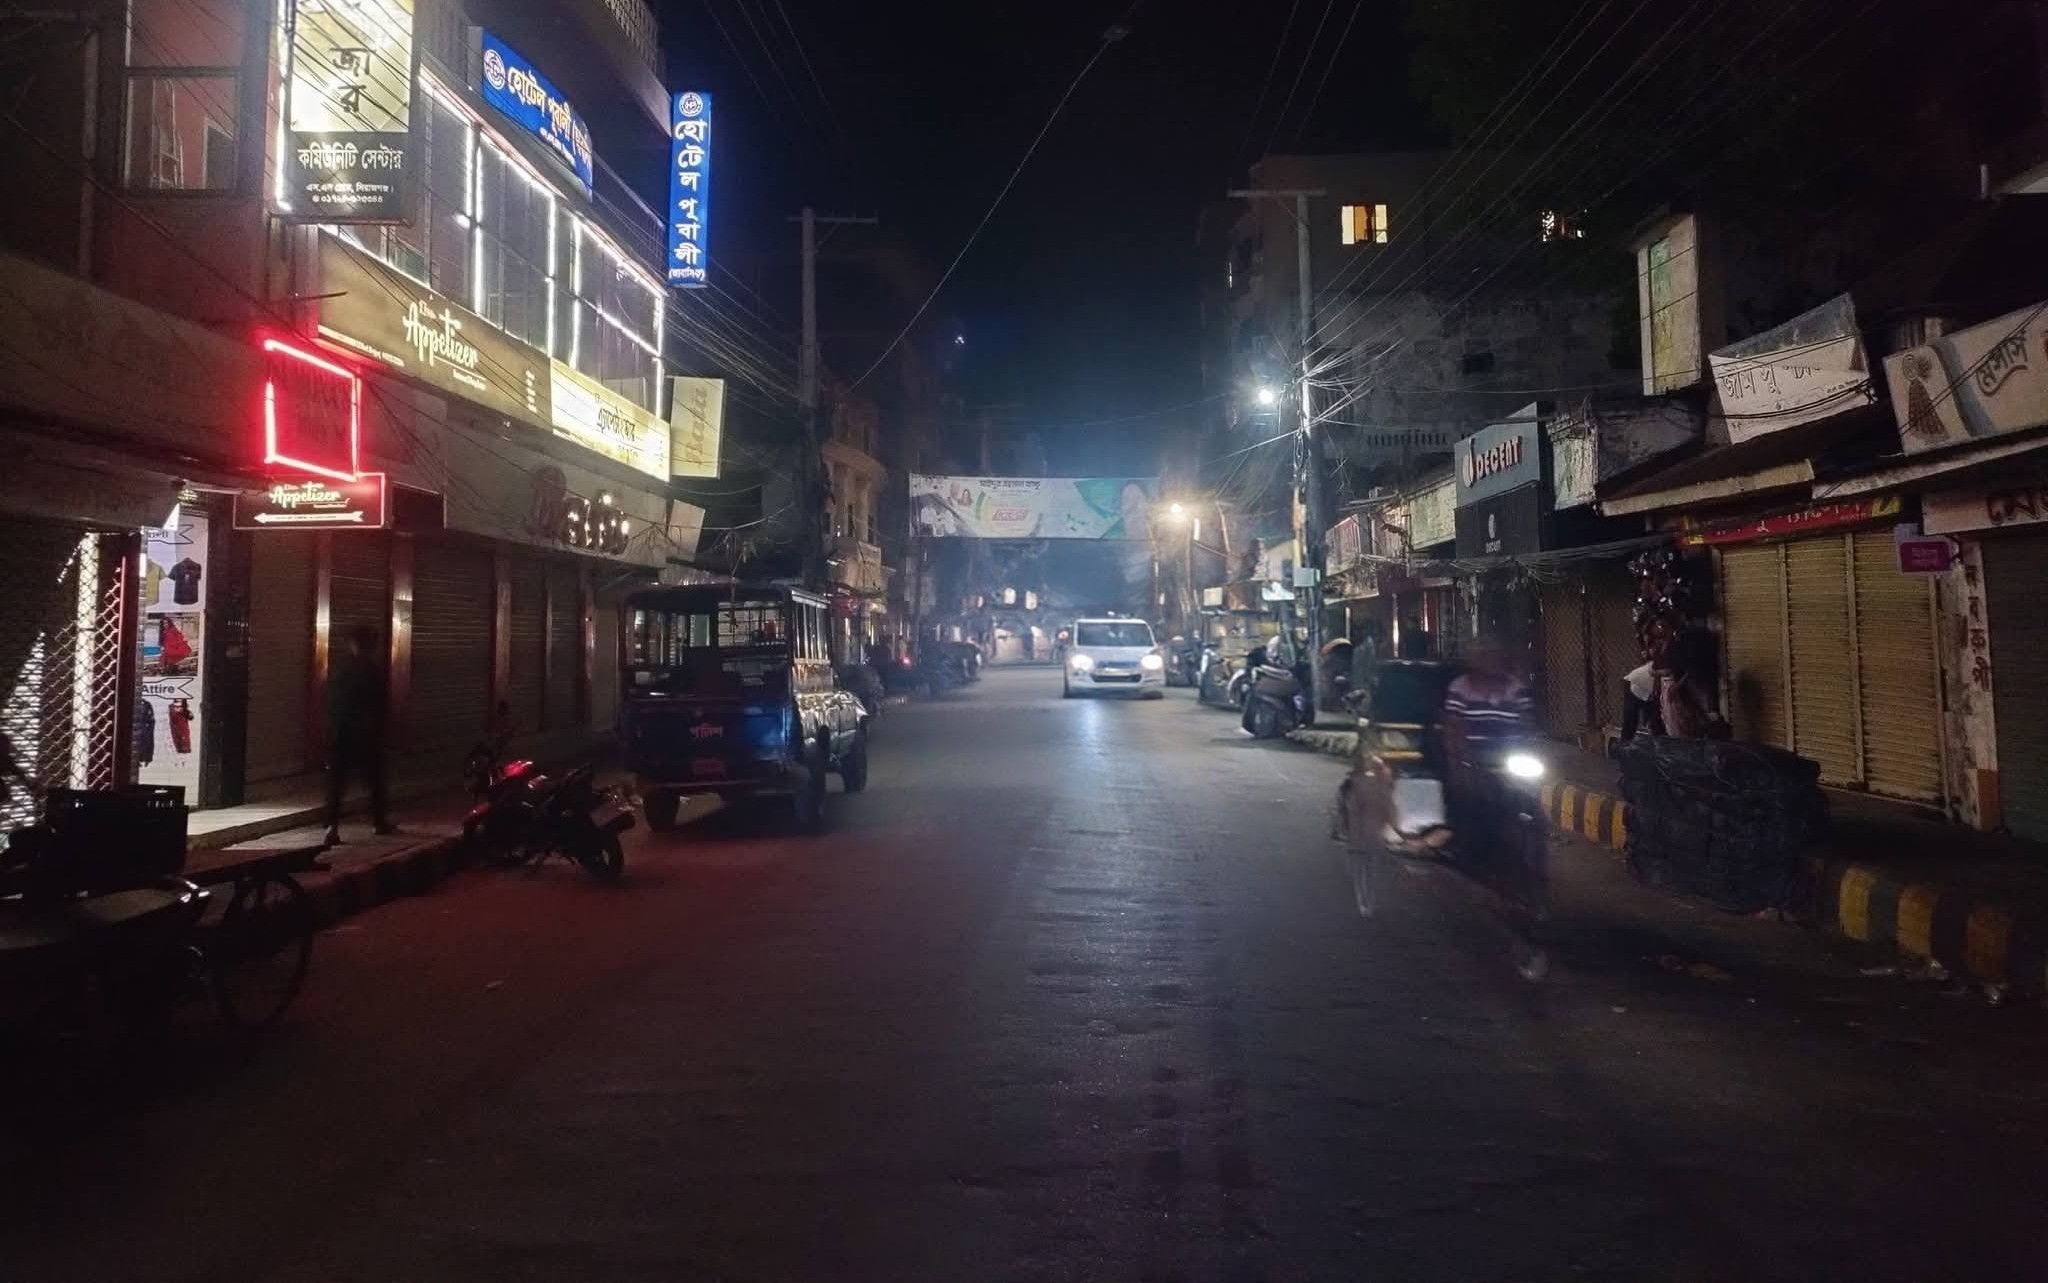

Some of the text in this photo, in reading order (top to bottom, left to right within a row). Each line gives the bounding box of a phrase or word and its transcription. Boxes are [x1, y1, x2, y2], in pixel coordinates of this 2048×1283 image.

[297, 141, 404, 170] কমিউনিটি সেন্টার
[674, 119, 708, 266] হোটেল পূবালী
[402, 301, 478, 368] Appetizer
[268, 481, 341, 509] Appetizer
